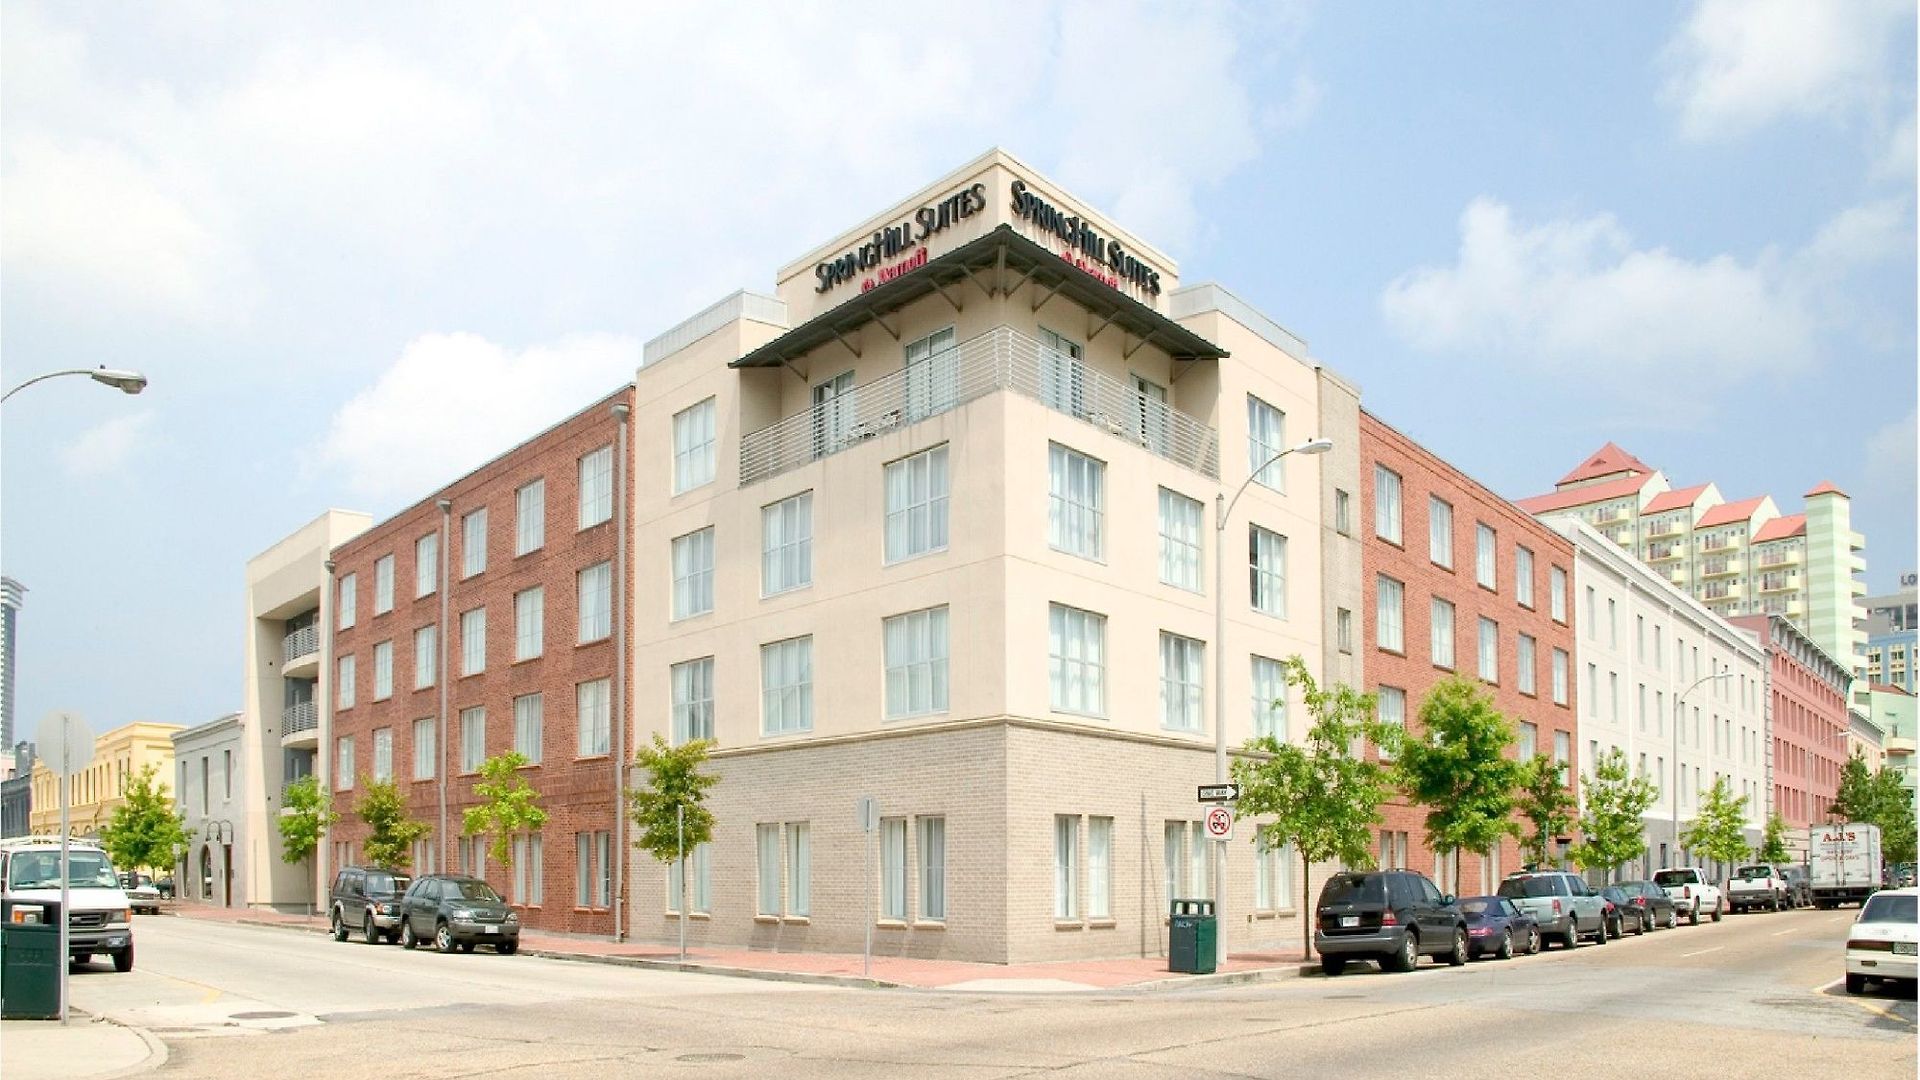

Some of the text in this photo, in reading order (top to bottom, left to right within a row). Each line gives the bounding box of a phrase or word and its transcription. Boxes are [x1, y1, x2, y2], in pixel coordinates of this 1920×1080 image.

[815, 183, 987, 294] SPRINGHILL SUITES
[1107, 240, 1161, 296] SUITES
[1901, 573, 1917, 586] LO
